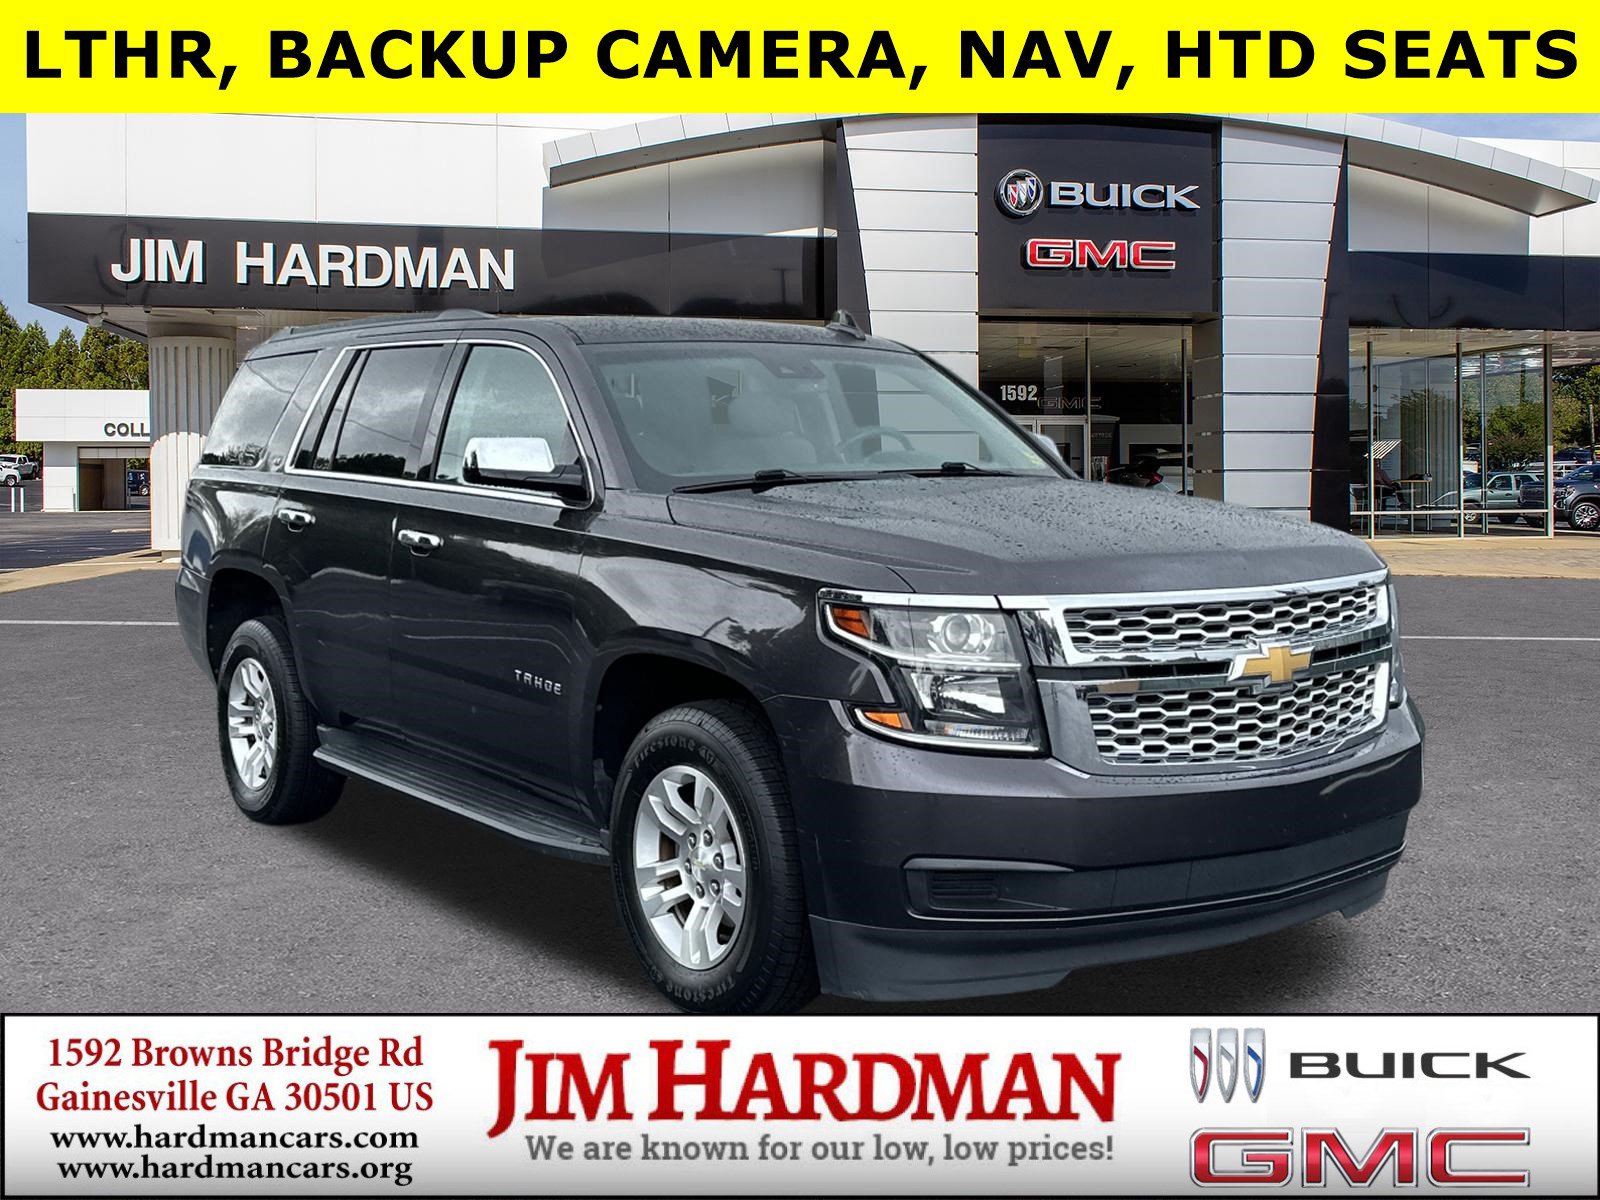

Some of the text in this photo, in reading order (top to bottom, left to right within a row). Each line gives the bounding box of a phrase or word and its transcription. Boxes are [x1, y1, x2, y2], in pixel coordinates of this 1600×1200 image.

[1050, 181, 1201, 210] BUICK
[111, 238, 514, 290] JIM HARDMAN
[1025, 238, 1177, 271] GMC
[1000, 384, 1038, 401] 1592
[1037, 396, 1104, 409] GMC
[104, 422, 150, 437] COLL
[514, 669, 562, 695] TAHOE
